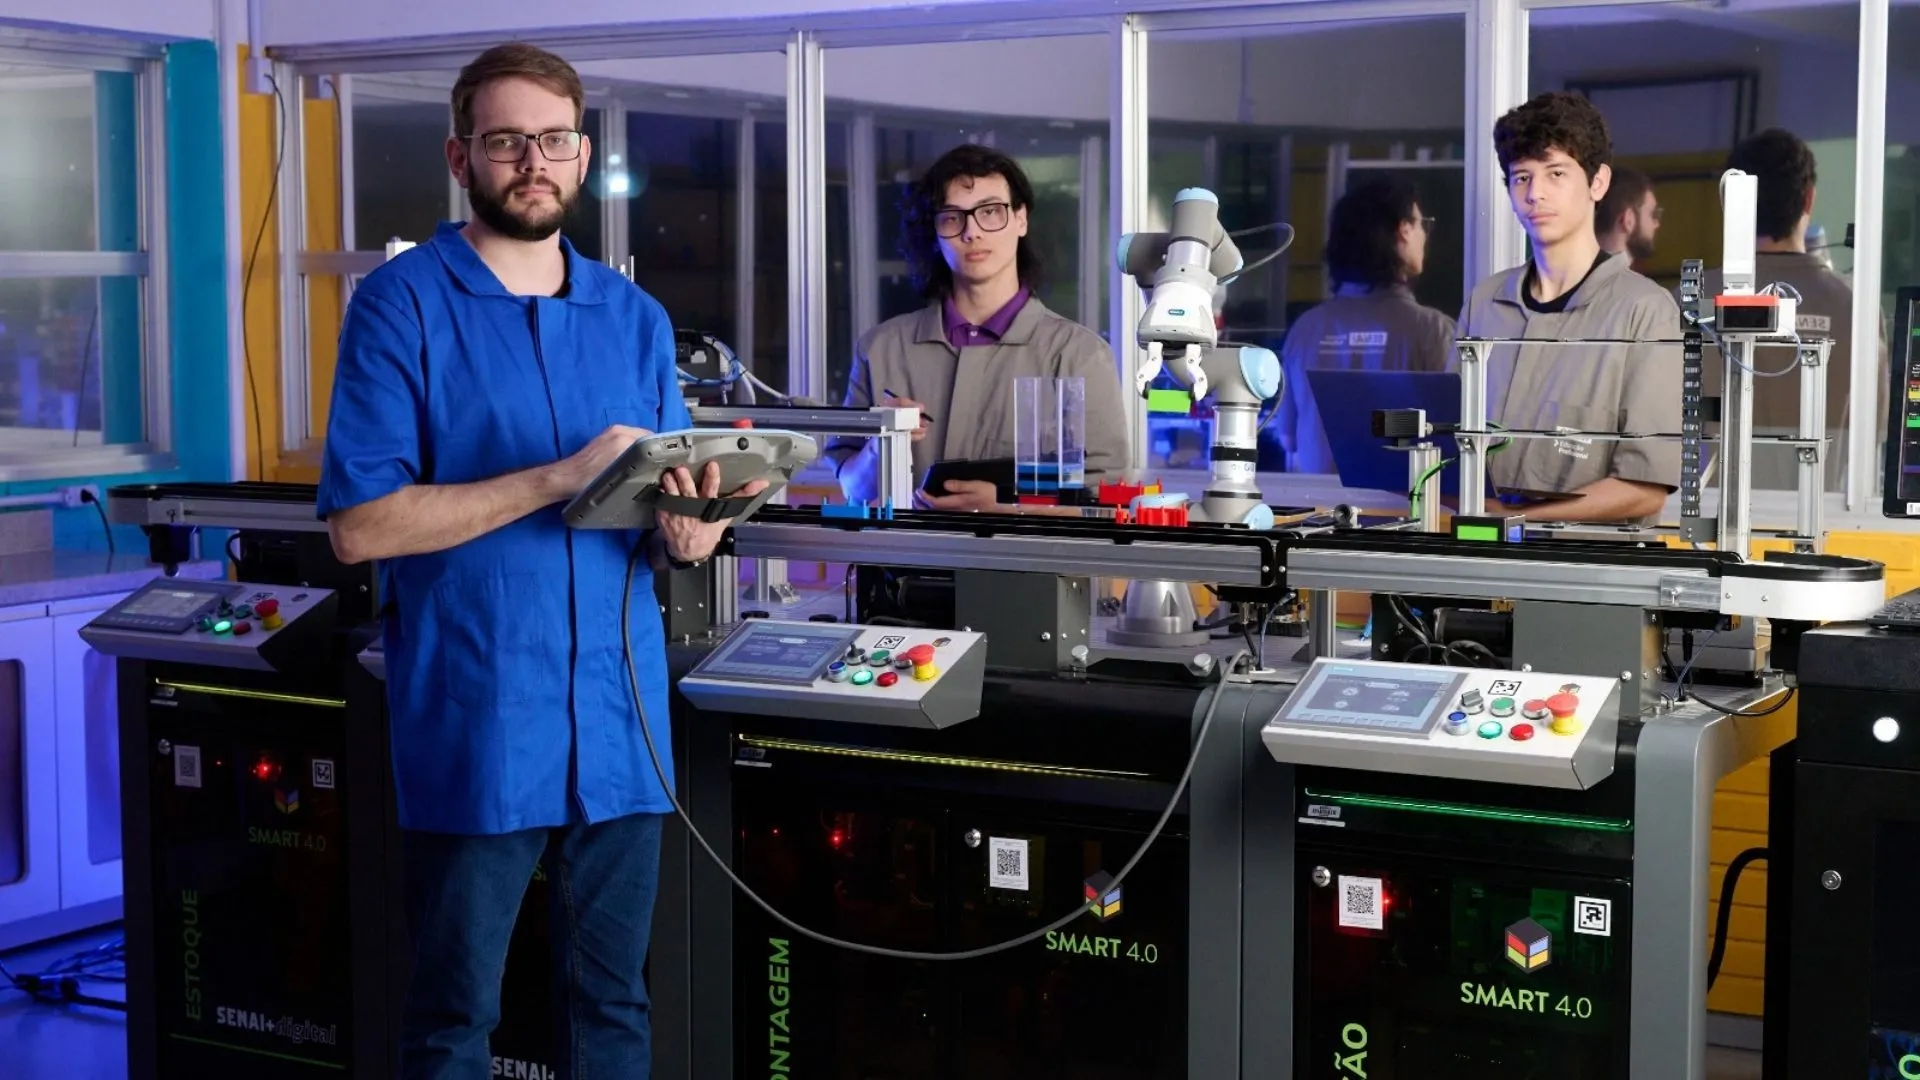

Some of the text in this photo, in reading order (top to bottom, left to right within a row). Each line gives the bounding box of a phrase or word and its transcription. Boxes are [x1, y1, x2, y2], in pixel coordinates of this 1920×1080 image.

[248, 825, 327, 852] SMART 4.0
[182, 888, 203, 1021] ESTOQUE
[1045, 930, 1158, 964] SMART 4.0
[1460, 981, 1592, 1019] SMART 4.0
[1334, 1022, 1368, 1080] ÃO
